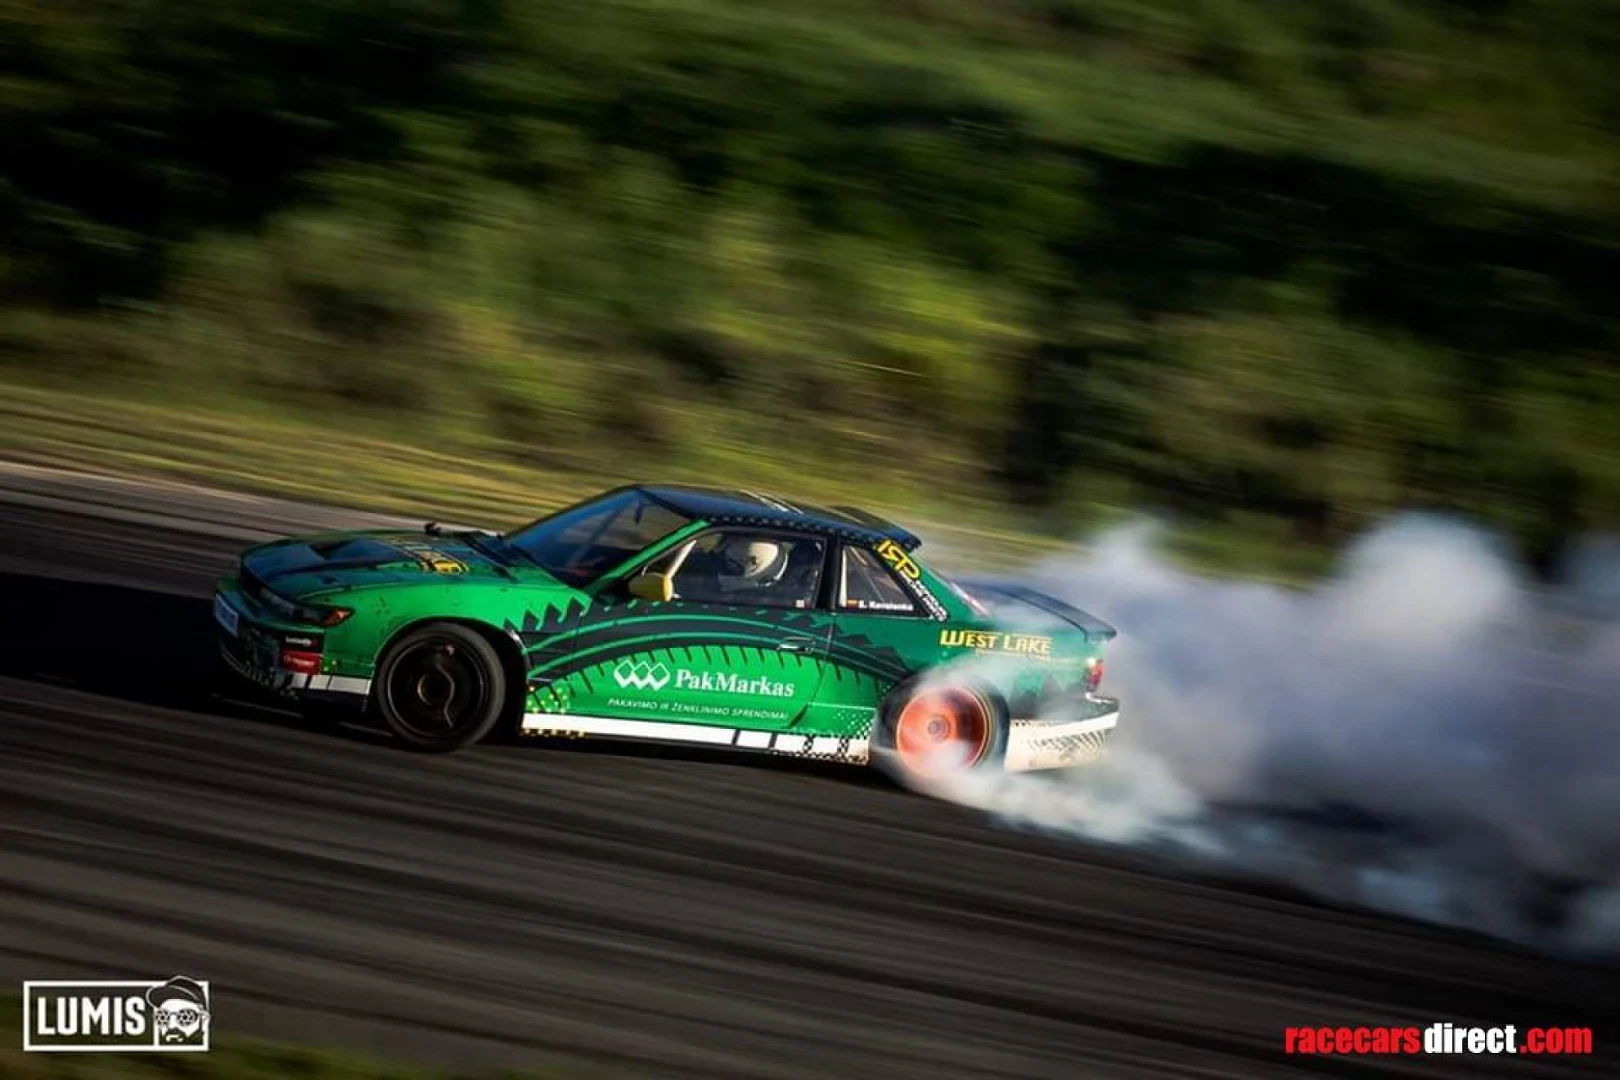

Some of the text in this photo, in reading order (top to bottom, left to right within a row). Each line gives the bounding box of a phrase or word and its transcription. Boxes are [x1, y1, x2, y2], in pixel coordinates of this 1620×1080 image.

[940, 630, 1052, 655] WEST LAKE
[675, 668, 795, 697] PakMarkas
[607, 698, 657, 710] PAKAVIMO
[671, 702, 730, 716] ŽENKLINIMO
